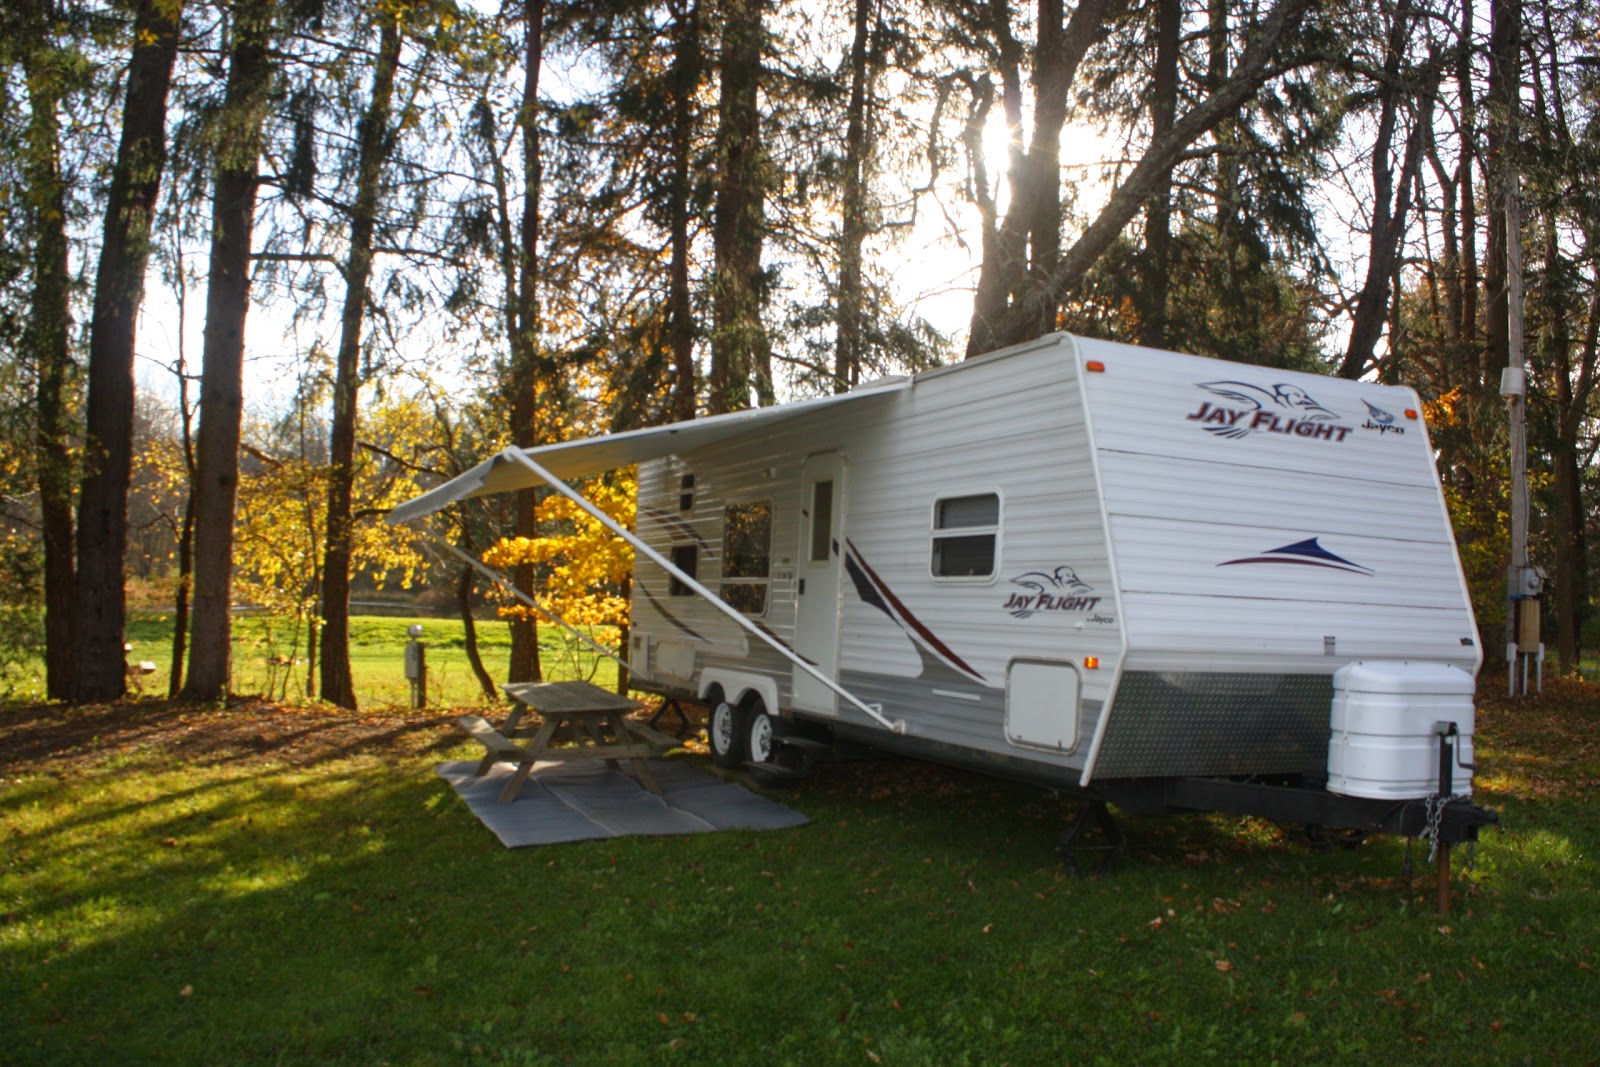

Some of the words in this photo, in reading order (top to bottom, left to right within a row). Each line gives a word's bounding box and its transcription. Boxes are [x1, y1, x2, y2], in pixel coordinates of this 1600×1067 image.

[1186, 402, 1249, 427] JAY
[1250, 411, 1353, 442] FLIGHT
[1361, 418, 1405, 436] Jayco
[1003, 593, 1035, 609] JAY
[1035, 593, 1101, 611] FLIGHT
